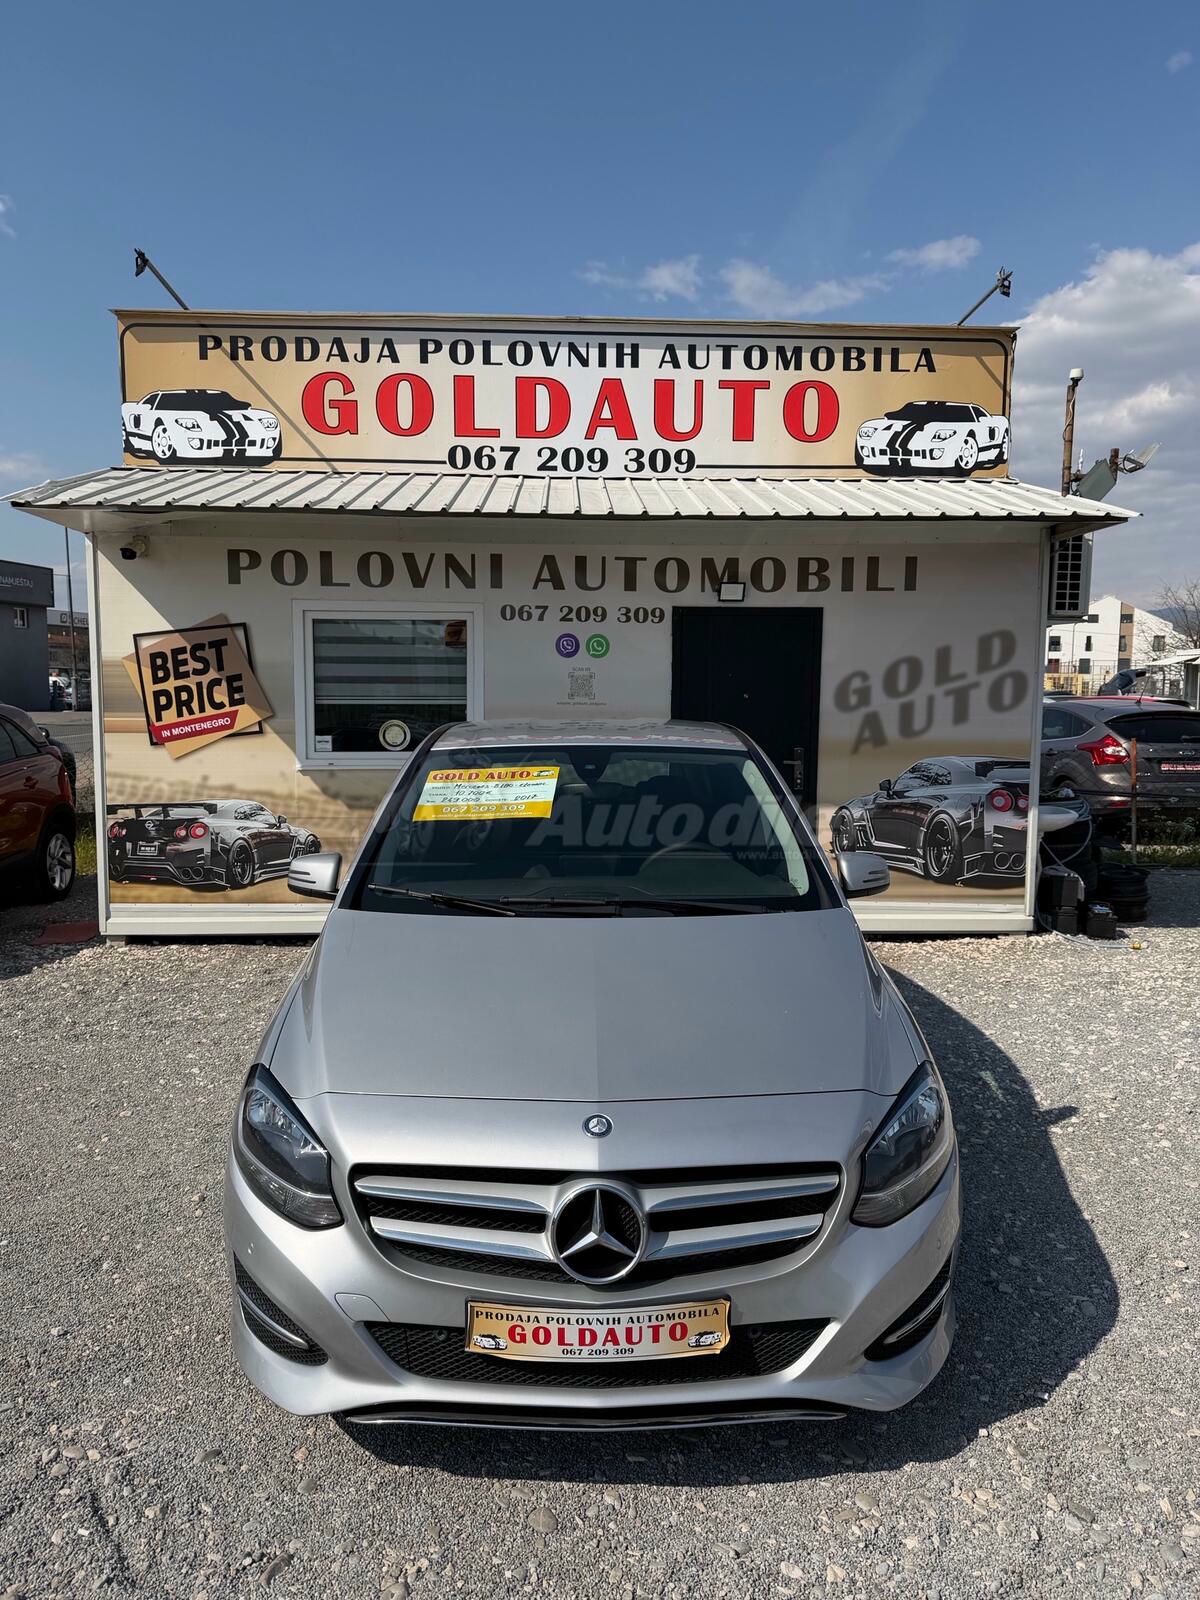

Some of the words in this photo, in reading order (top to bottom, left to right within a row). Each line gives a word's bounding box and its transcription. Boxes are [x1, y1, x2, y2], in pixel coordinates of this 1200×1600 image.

[198, 334, 401, 364] PRODAJA
[418, 338, 640, 369] POLOVNIH
[658, 344, 937, 373] AUTOMOBILA
[301, 371, 840, 443] GOLDAUTO
[447, 444, 521, 471] 067
[536, 445, 609, 473] 209
[624, 447, 696, 474] 309
[226, 548, 504, 590] POLOVNI
[531, 554, 918, 593] AUTOMOBILI
[500, 604, 549, 622] 067
[559, 605, 608, 623] 209
[616, 606, 666, 624] 309
[149, 638, 228, 685] BEST
[833, 628, 1017, 713] GOLD
[152, 673, 246, 722] PRICE
[851, 669, 1029, 755] AUTO
[161, 729, 171, 738] IN
[171, 717, 231, 736] MONTENEGRO
[432, 772, 480, 781] GOLD
[485, 771, 531, 780] AUTO
[475, 1310, 541, 1324] PRODAJA
[546, 1316, 621, 1326] POLOVNIH
[626, 1307, 720, 1324] AUTOMOBILA
[507, 1322, 688, 1347] GOLDAUTO
[587, 1348, 609, 1356] 209
[612, 1347, 634, 1355] 309
